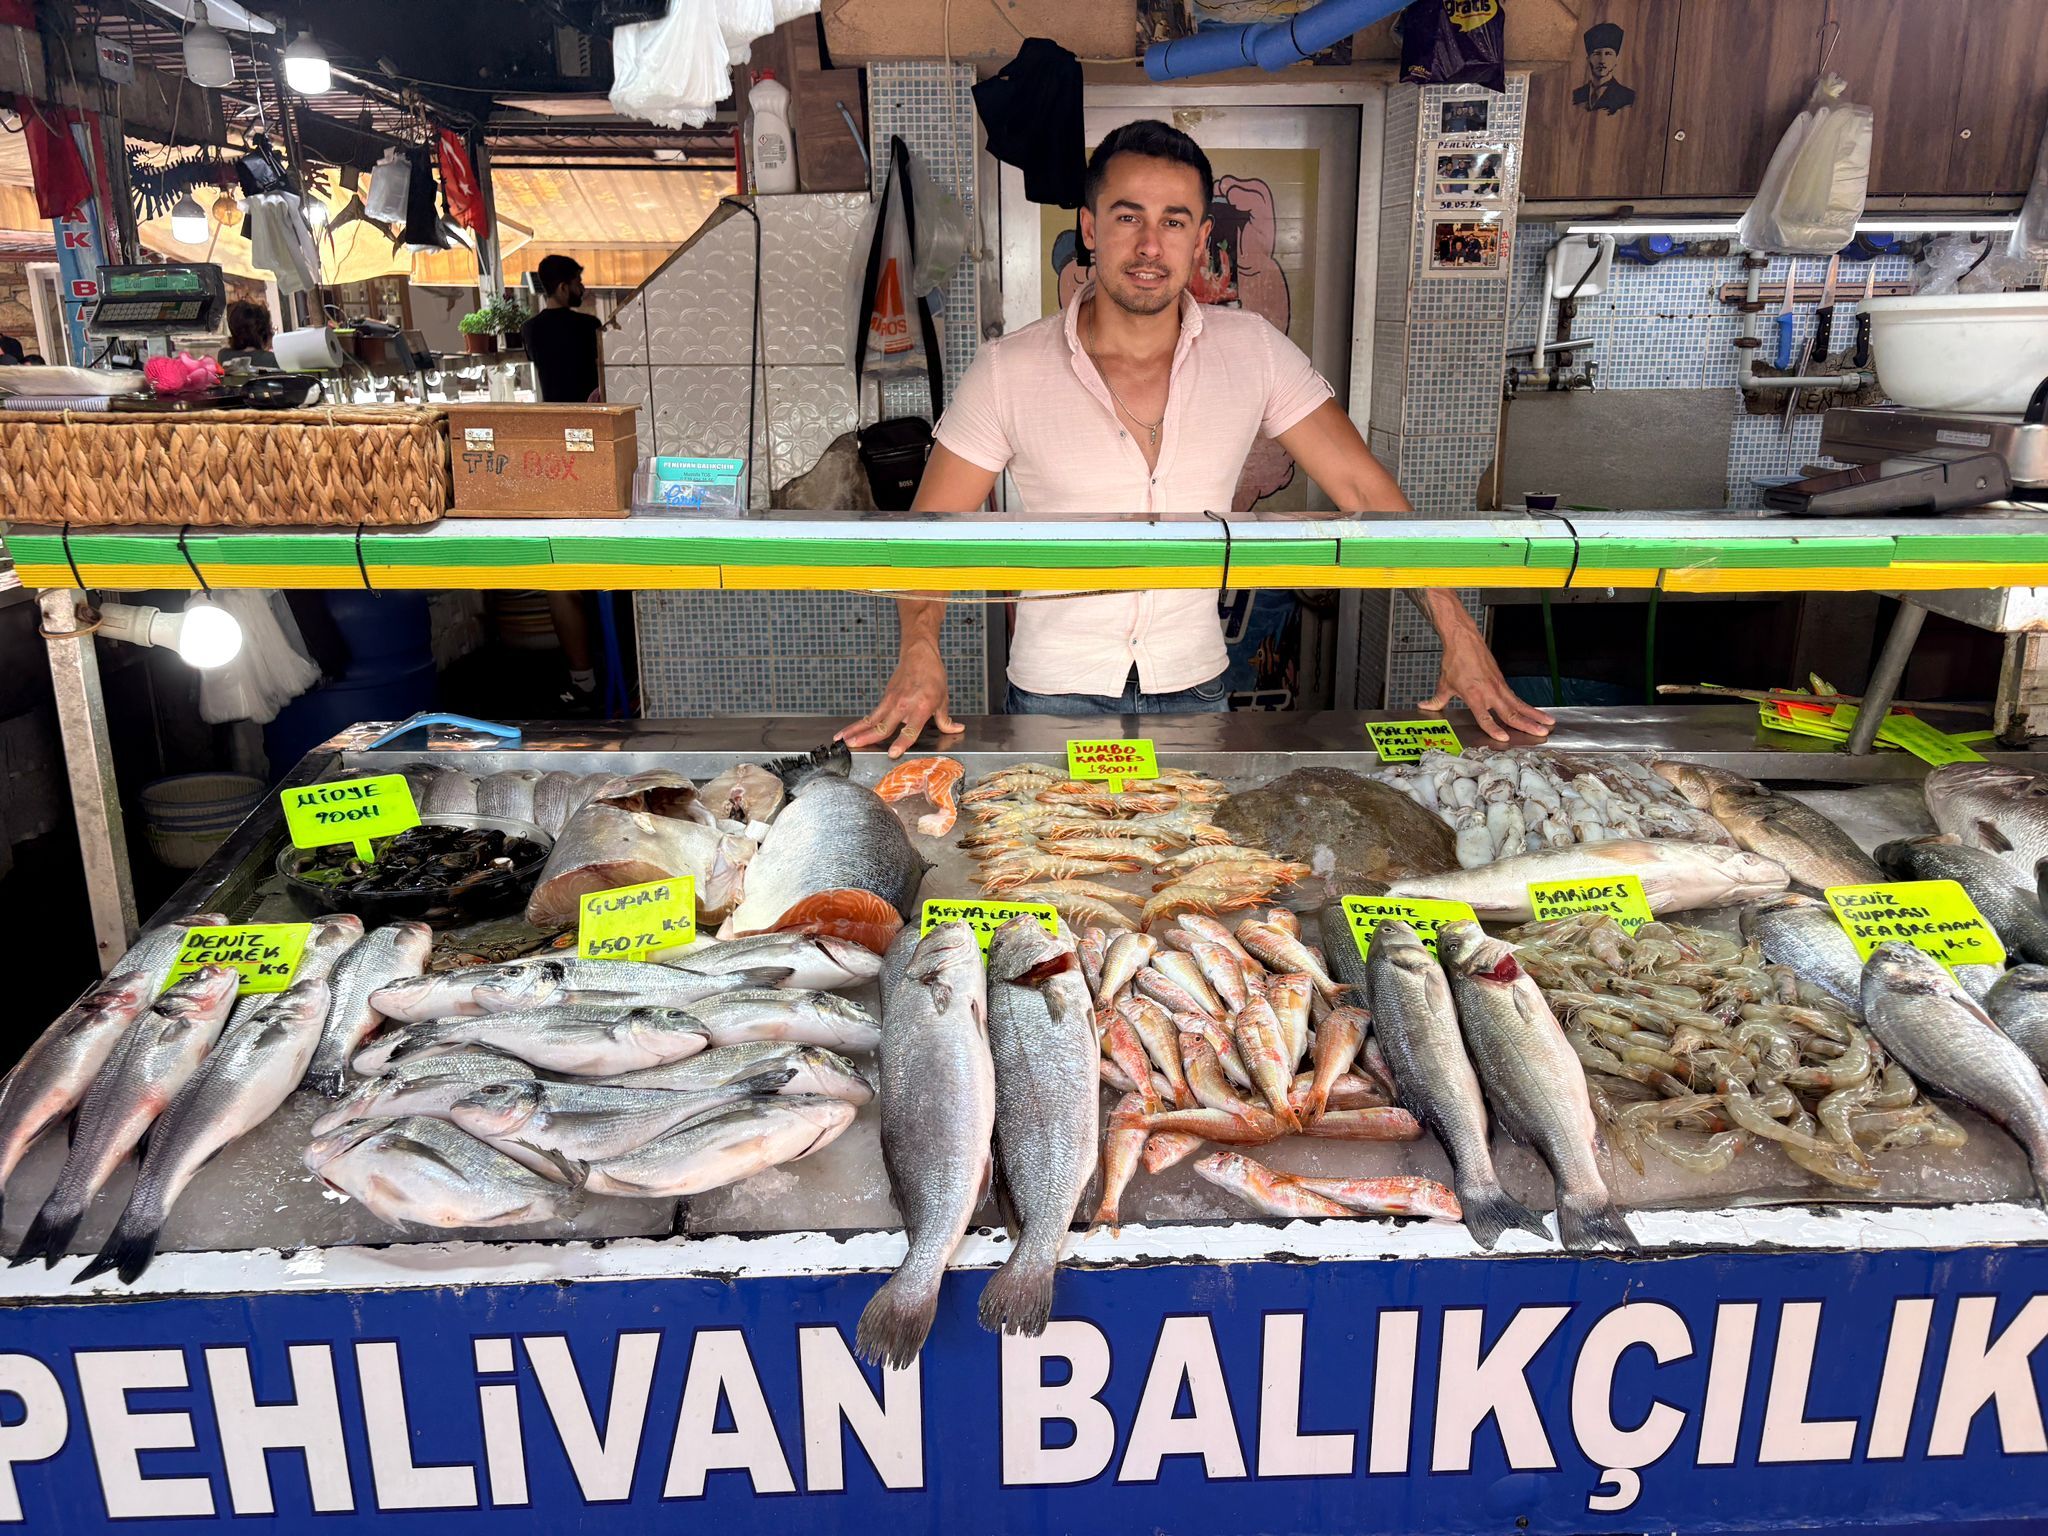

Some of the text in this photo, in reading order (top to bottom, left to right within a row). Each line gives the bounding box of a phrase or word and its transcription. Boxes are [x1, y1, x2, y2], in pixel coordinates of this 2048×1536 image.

[523, 450, 580, 480] BOX
[1370, 725, 1451, 737] KALAMAR
[1854, 924, 1893, 938] SEA
